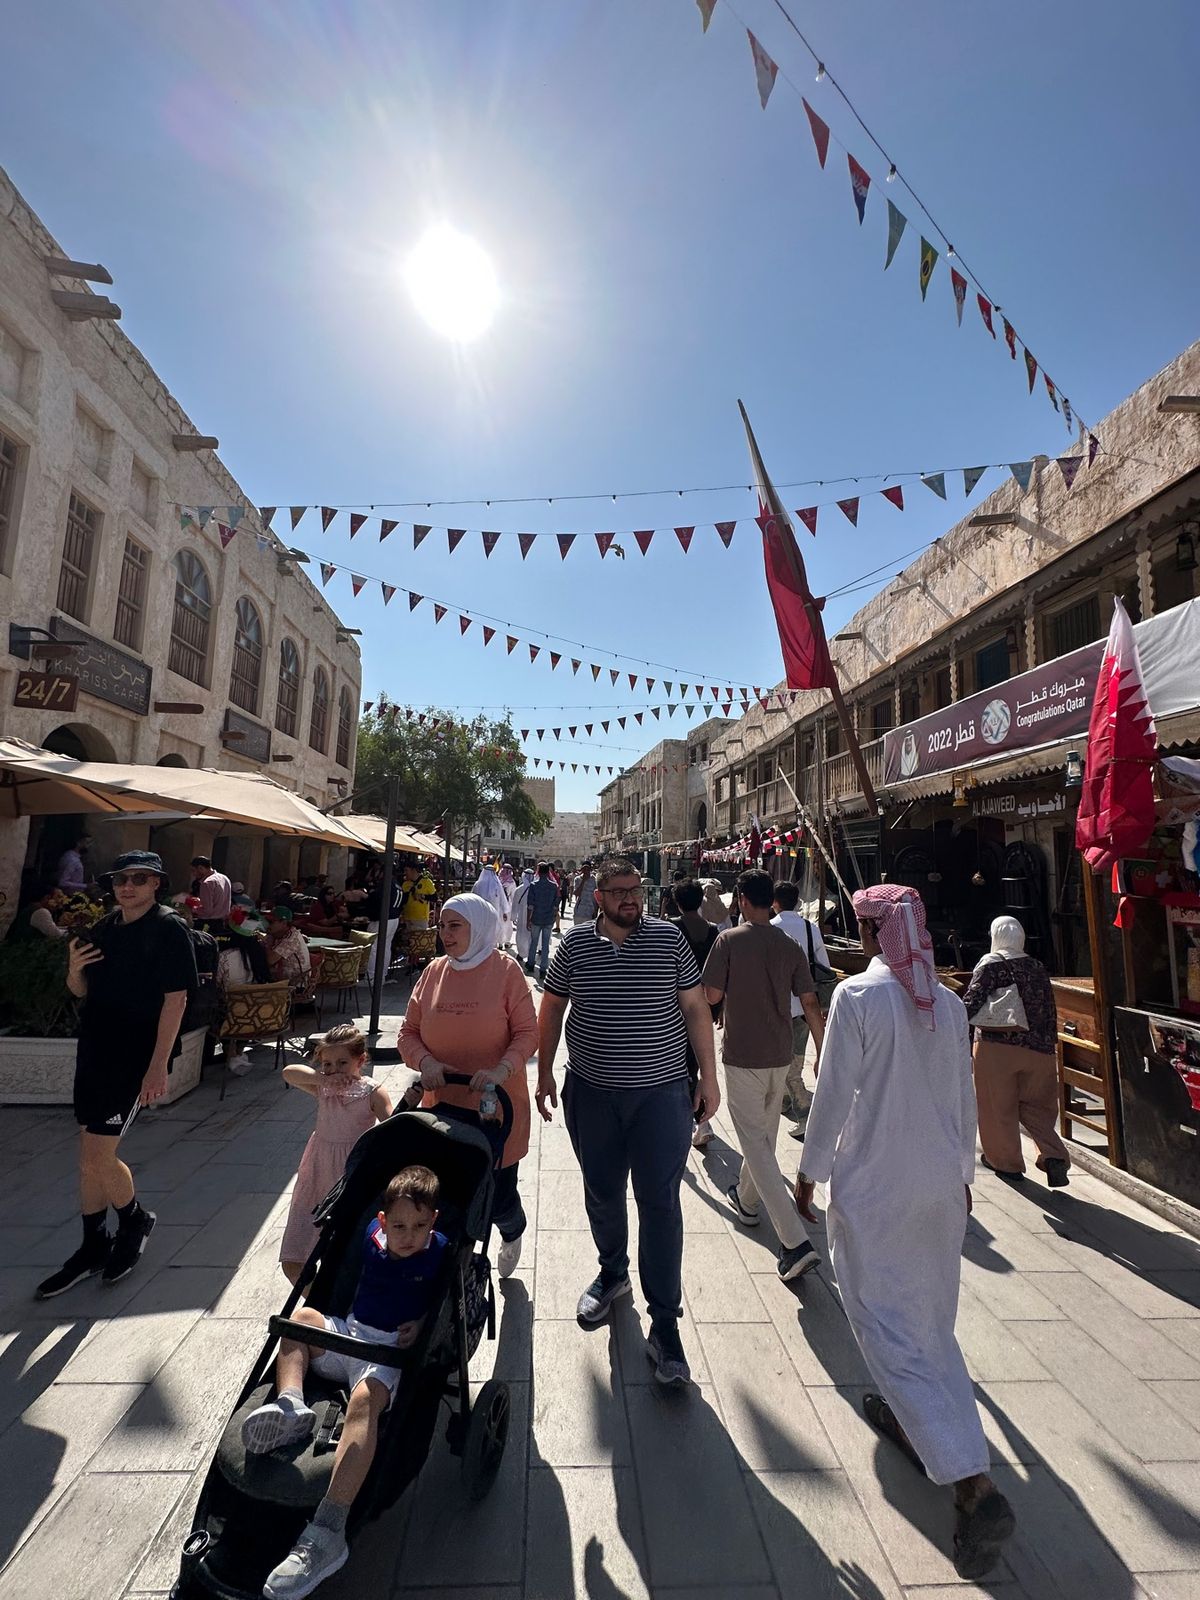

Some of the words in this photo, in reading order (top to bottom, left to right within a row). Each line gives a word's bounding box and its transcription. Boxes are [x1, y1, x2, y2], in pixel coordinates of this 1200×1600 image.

[17, 678, 71, 706] 24/7
[1016, 686, 1048, 713] قطر
[1049, 676, 1086, 698] مبروك
[1016, 704, 1065, 727] Congratulations
[1065, 696, 1086, 712] Qatar
[928, 727, 952, 754] 2022
[954, 719, 976, 751] قطر
[972, 800, 980, 816] AL
[981, 795, 1015, 814] AJAWEED
